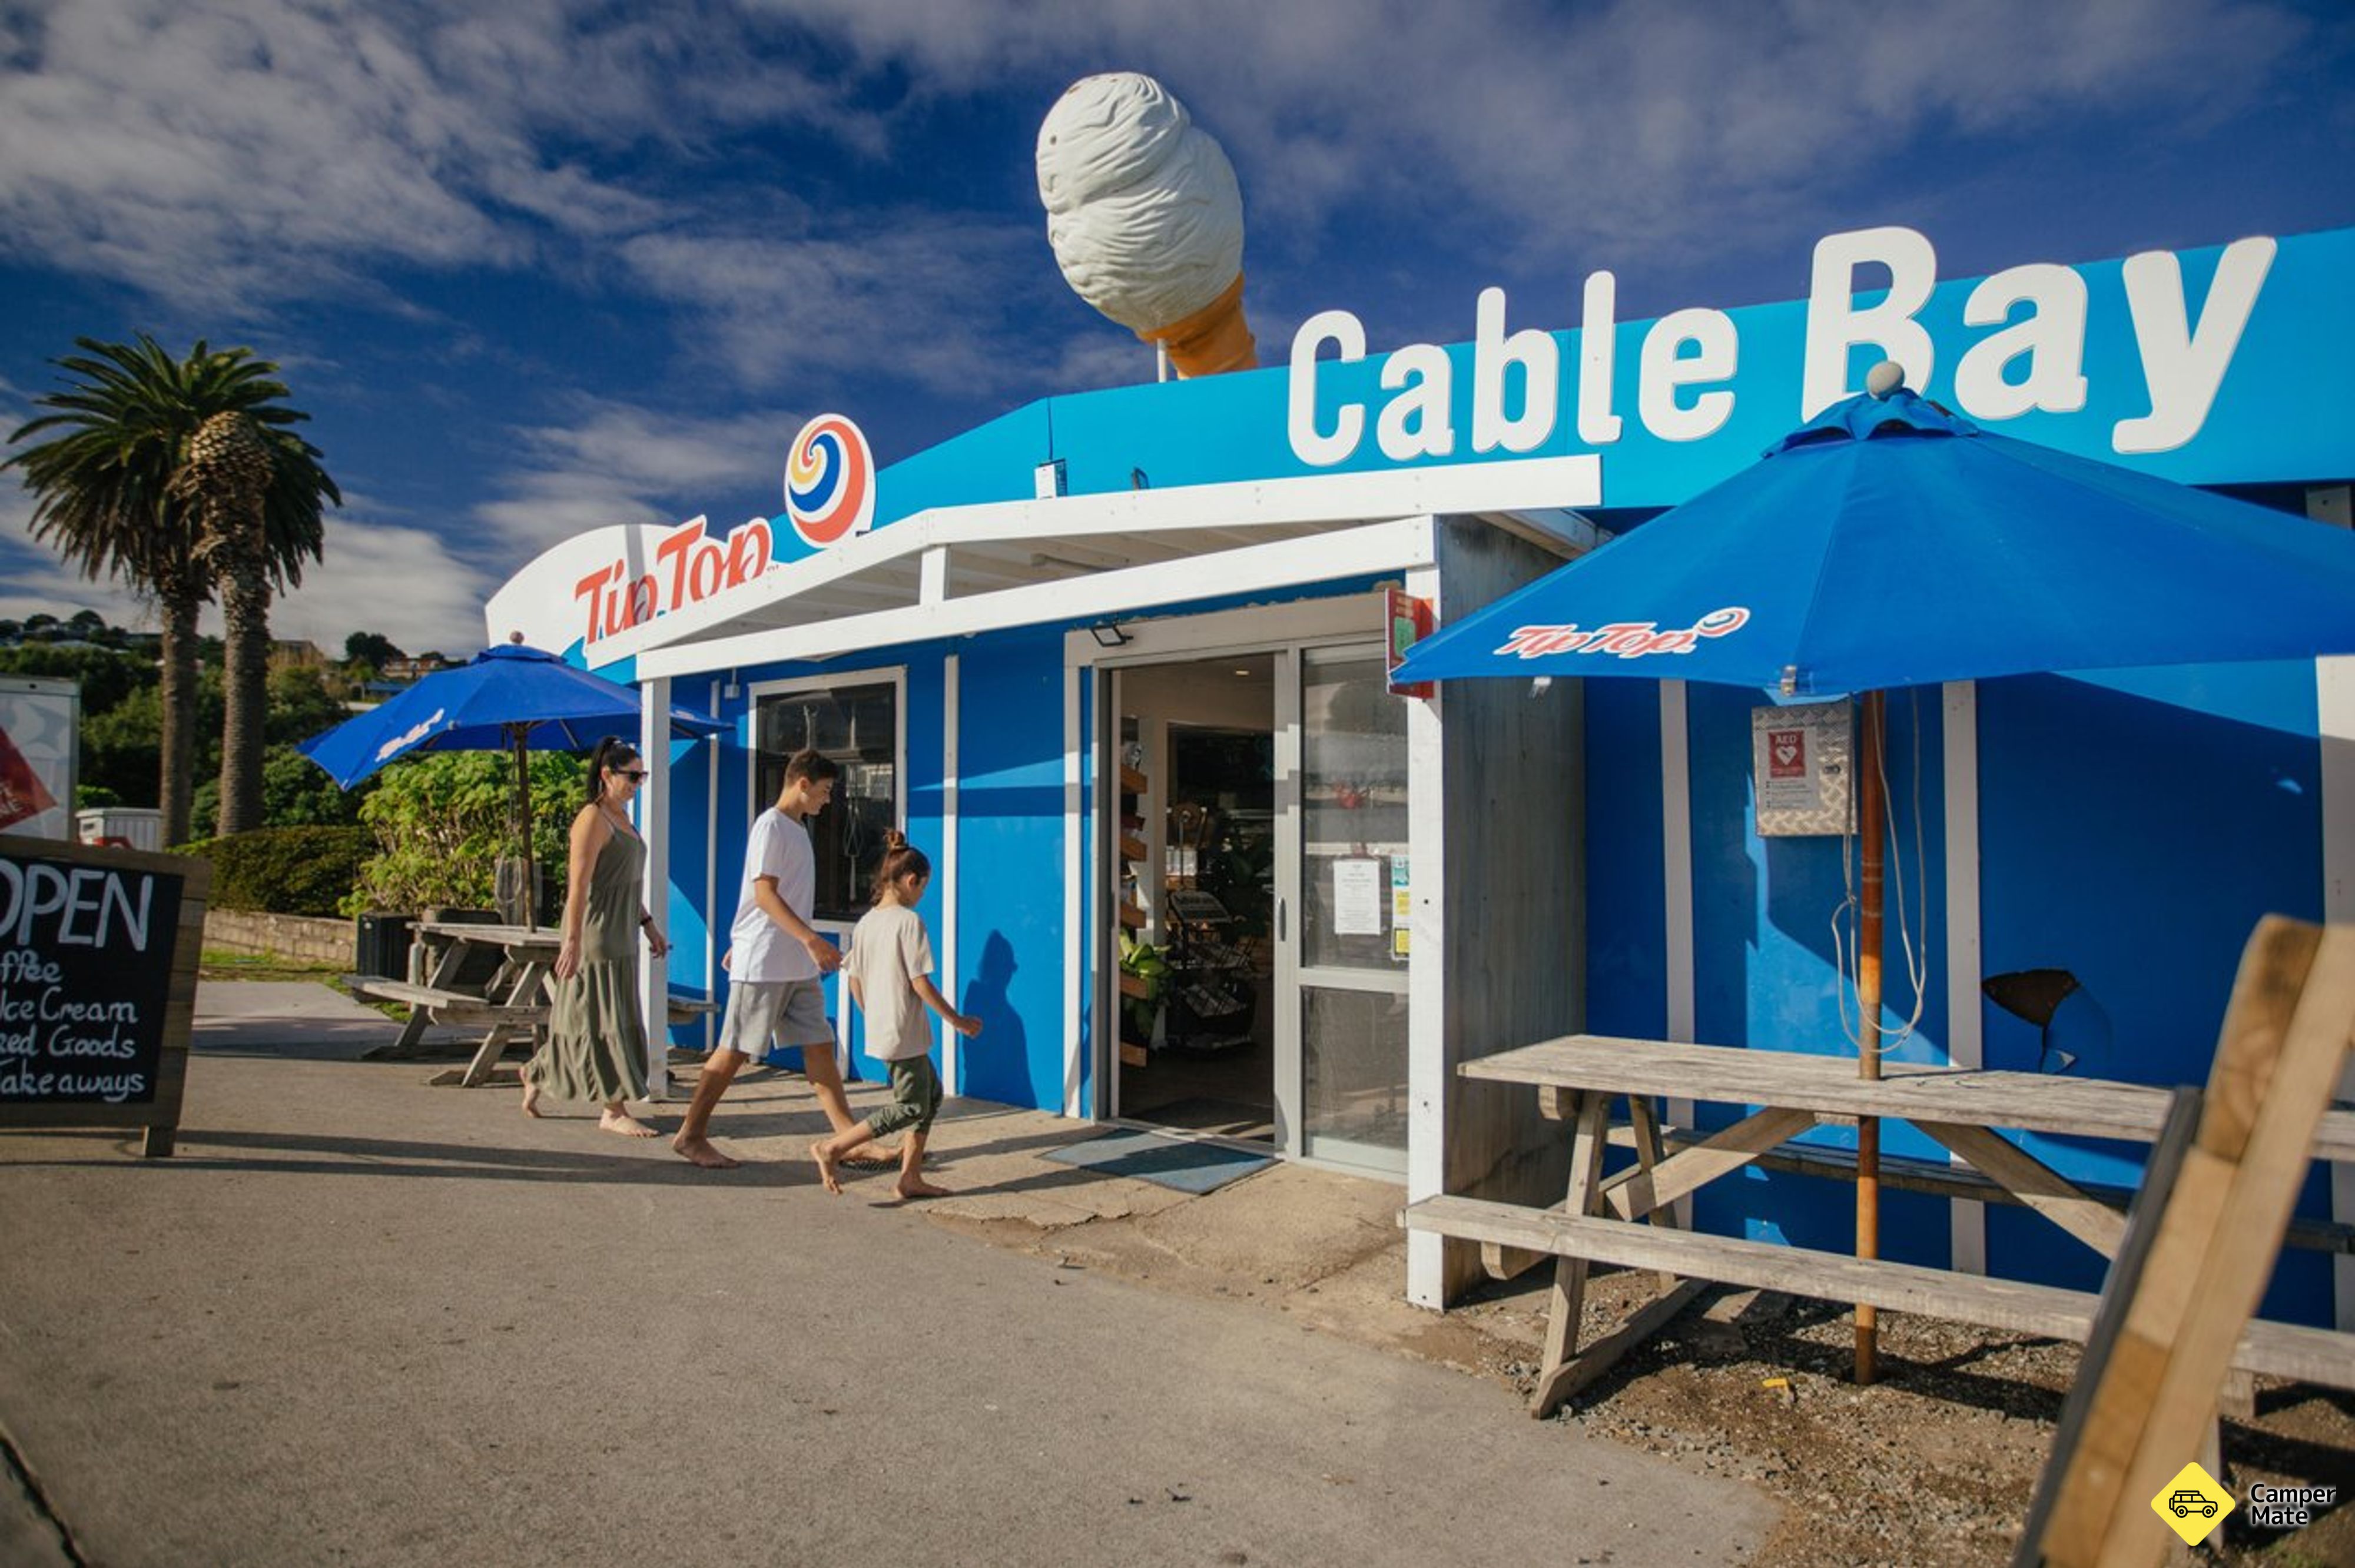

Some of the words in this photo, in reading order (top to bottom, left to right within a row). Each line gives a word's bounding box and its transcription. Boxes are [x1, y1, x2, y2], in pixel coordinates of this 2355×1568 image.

[1286, 270, 1740, 467] Cable
[1801, 225, 2277, 456] Bay
[575, 559, 658, 645] Tip
[656, 522, 770, 611] Top
[1493, 624, 1593, 659] Tip
[1577, 622, 1698, 659] Top
[1774, 735, 1797, 745] AED
[0, 949, 63, 983] ffee
[39, 985, 139, 1024] Cream
[48, 1023, 136, 1059] Goods
